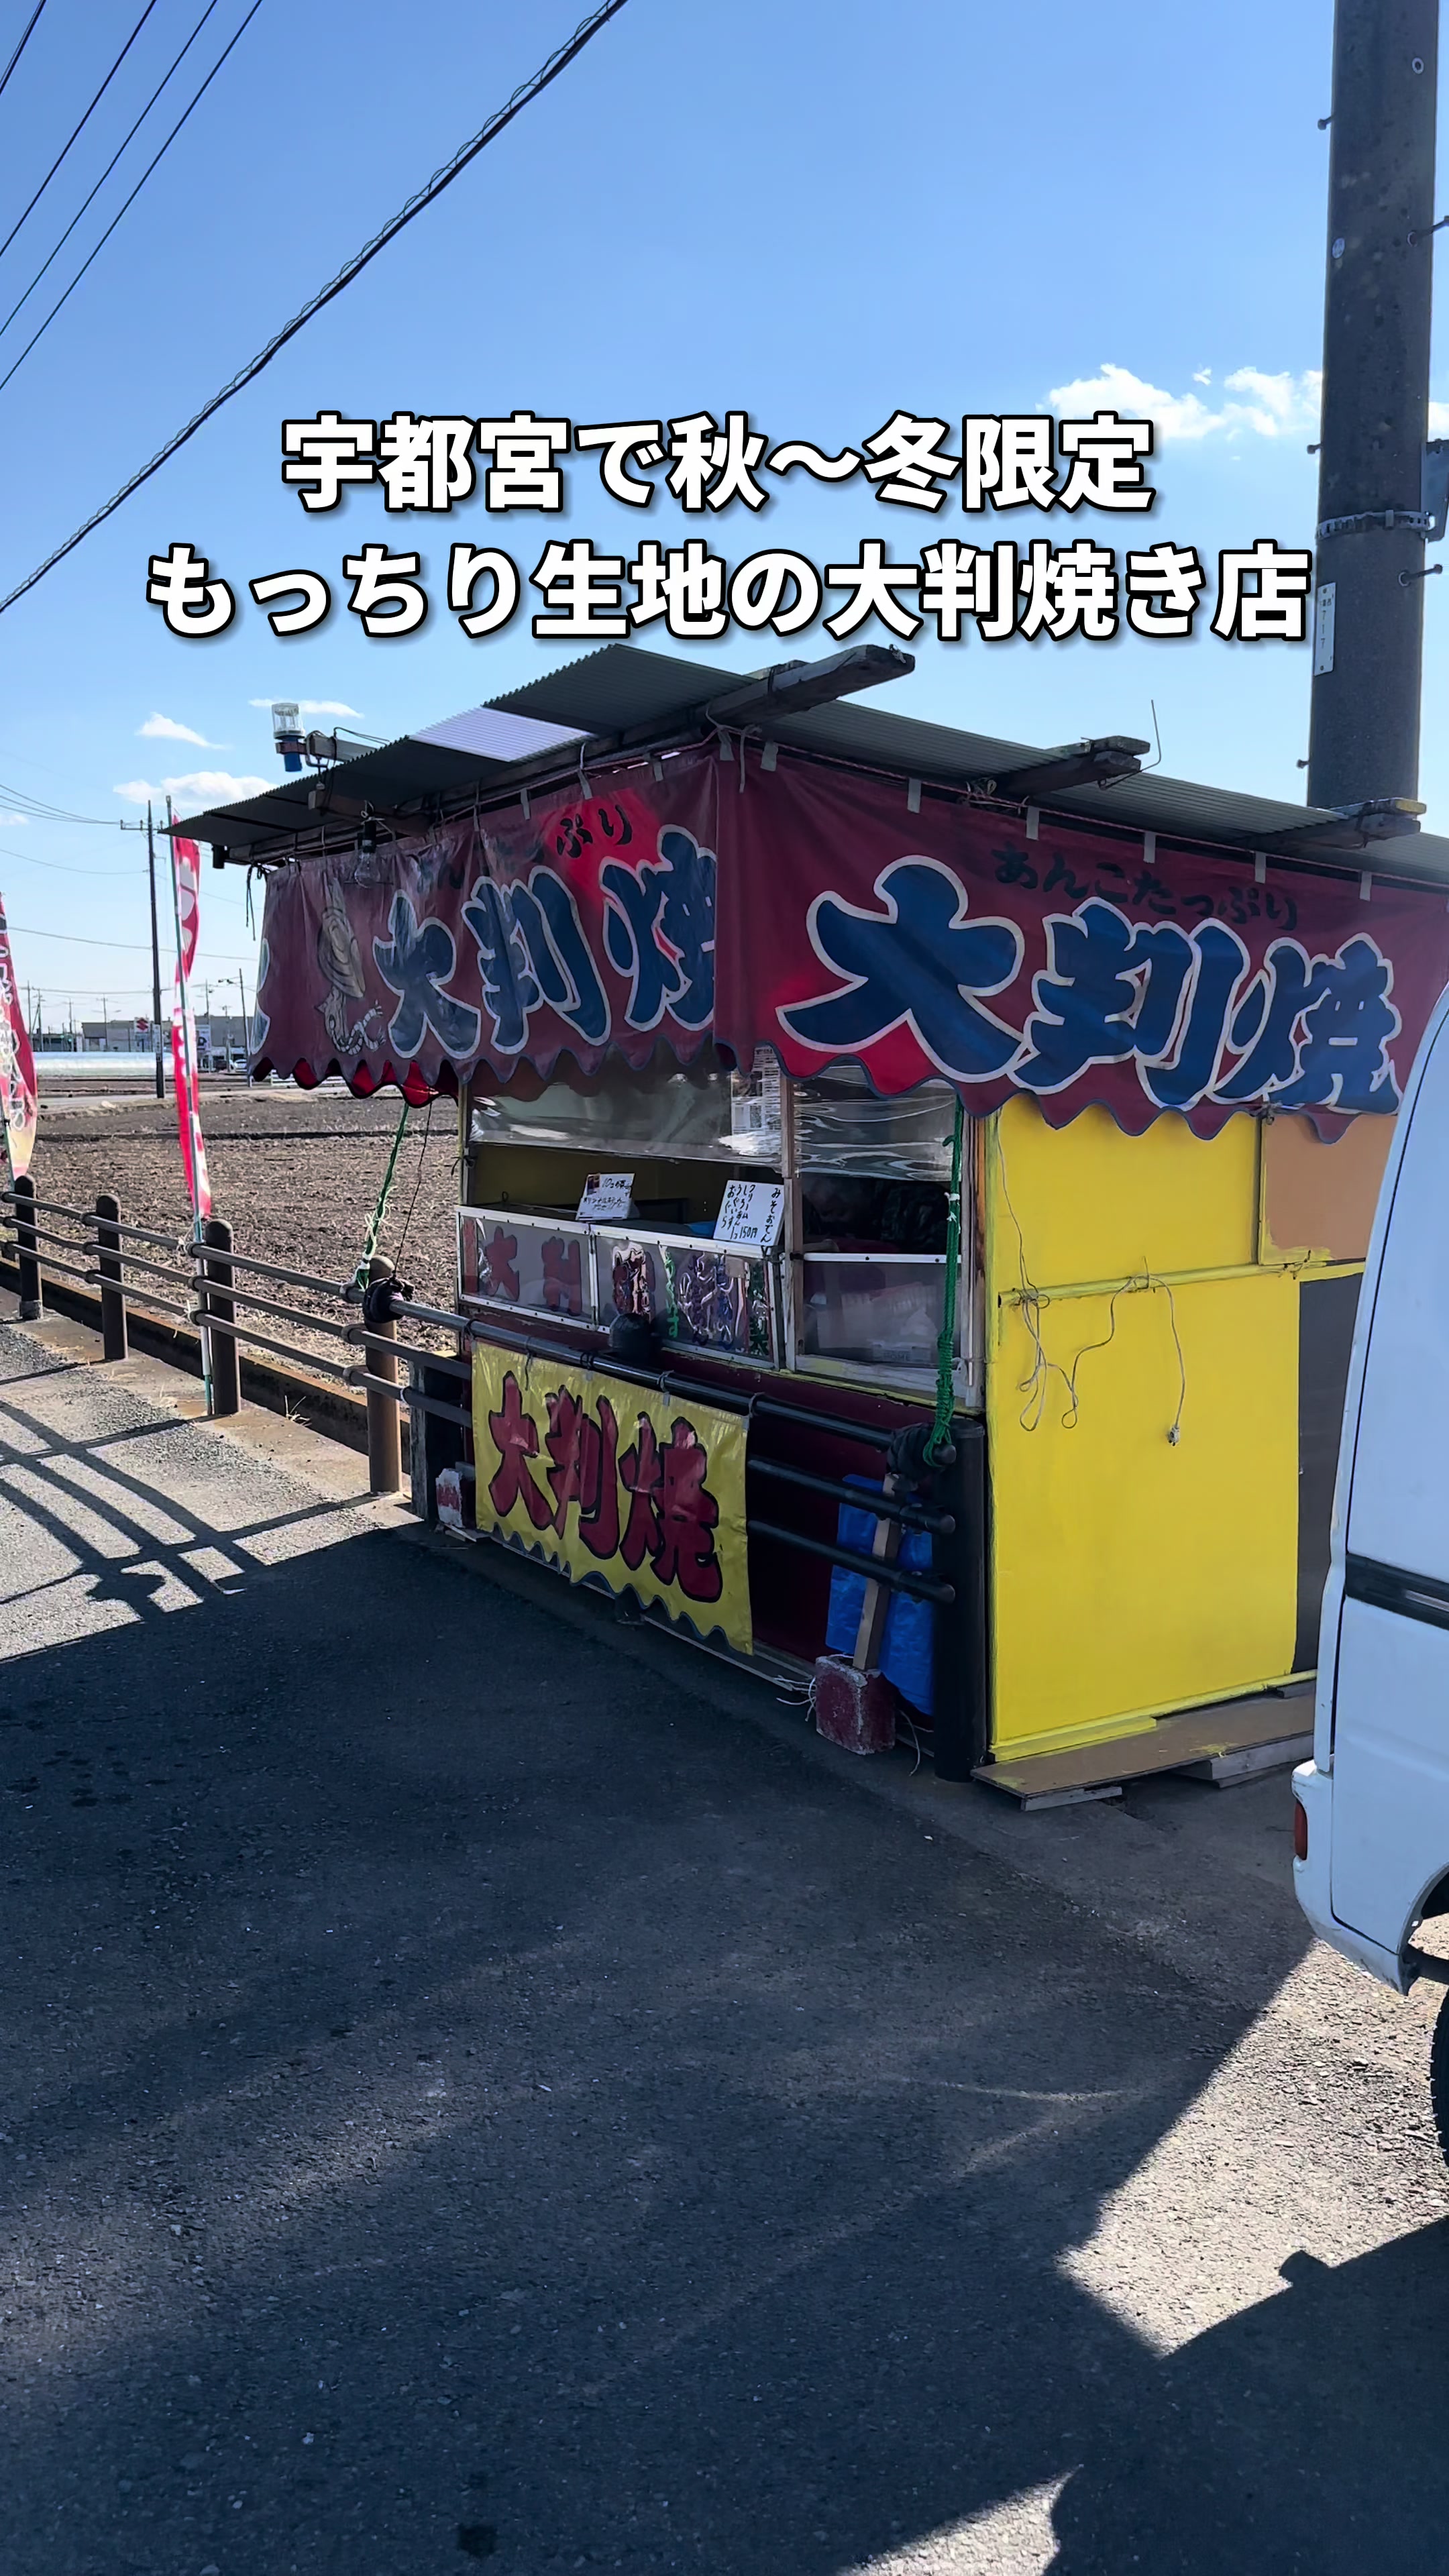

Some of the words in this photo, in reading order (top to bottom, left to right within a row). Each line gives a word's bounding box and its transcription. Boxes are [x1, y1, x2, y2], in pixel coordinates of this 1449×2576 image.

[775, 854, 1401, 1112] 大判焼
[721, 1184, 737, 1229] おぐら
[488, 1370, 722, 1603] 大判焼
